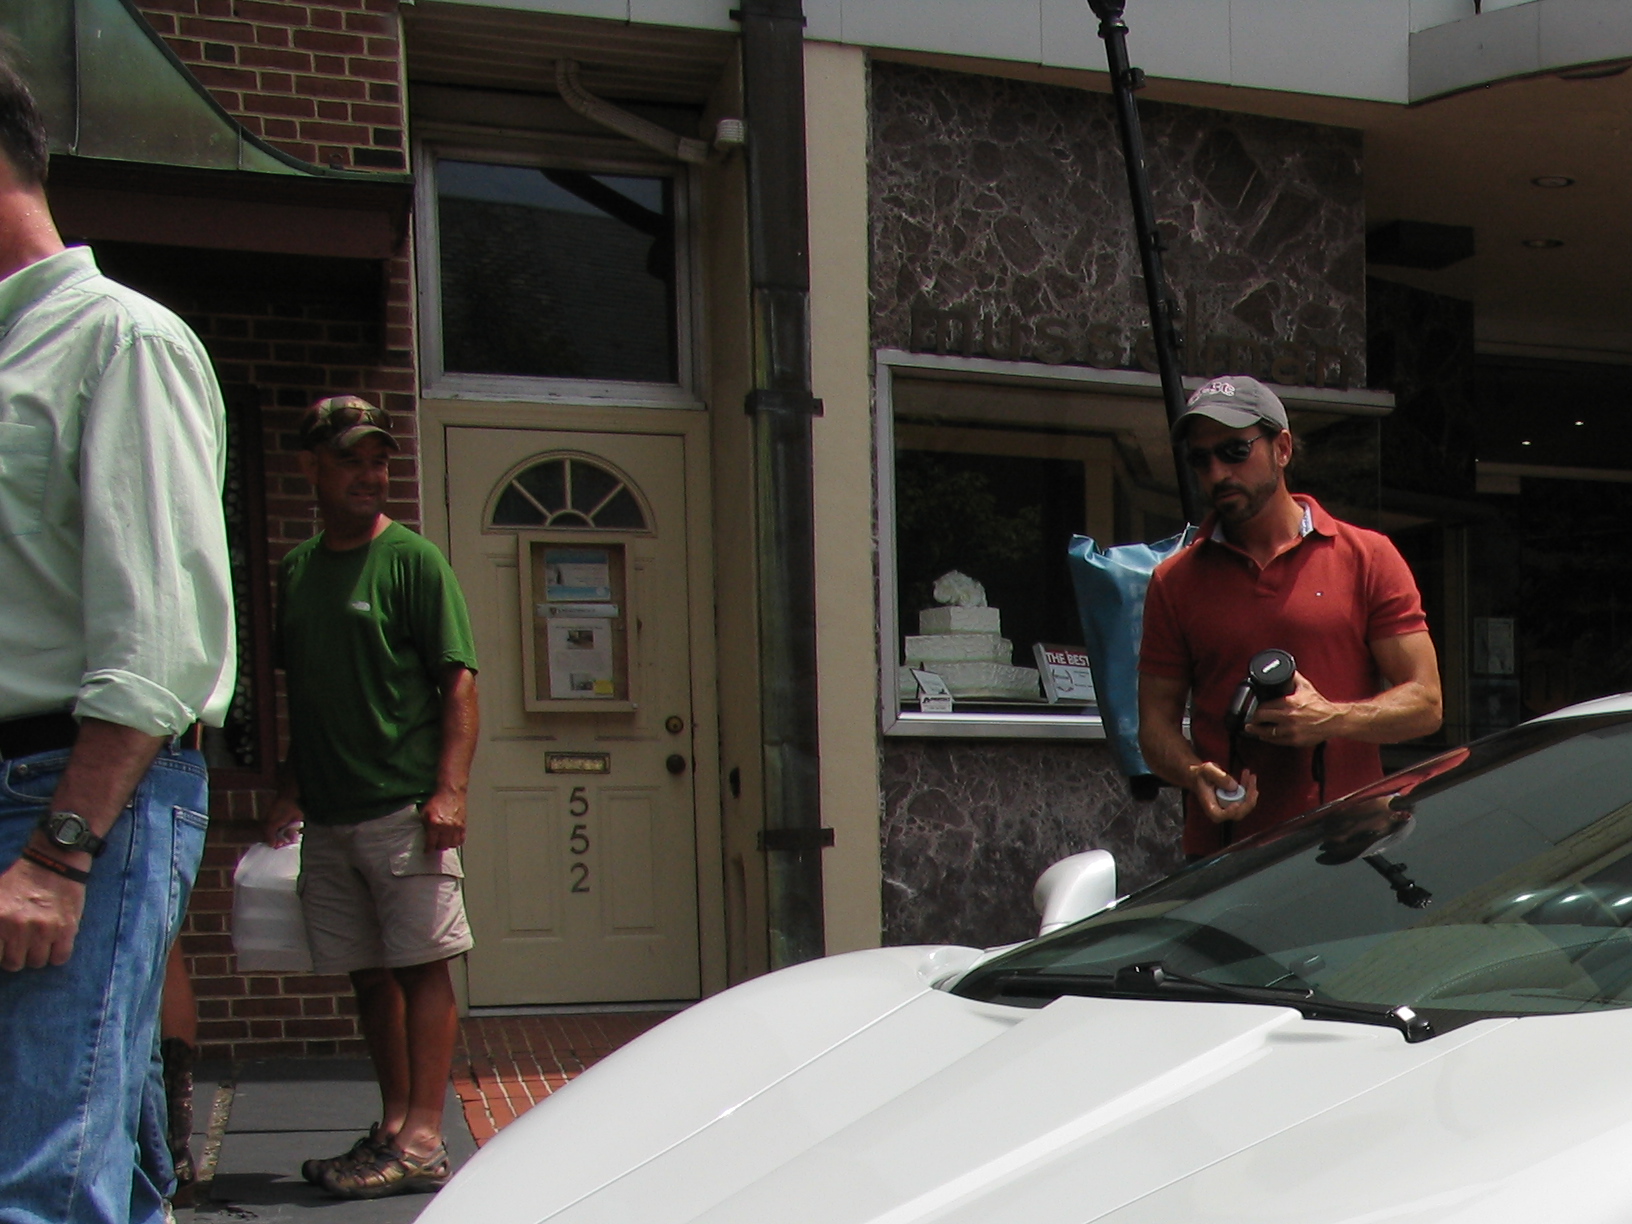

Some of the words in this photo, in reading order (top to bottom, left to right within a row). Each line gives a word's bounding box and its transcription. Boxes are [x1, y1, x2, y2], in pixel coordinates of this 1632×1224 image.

[910, 288, 1348, 391] musselman
[1045, 651, 1067, 665] THE
[1067, 652, 1090, 667] BEST
[569, 786, 590, 894] 552
